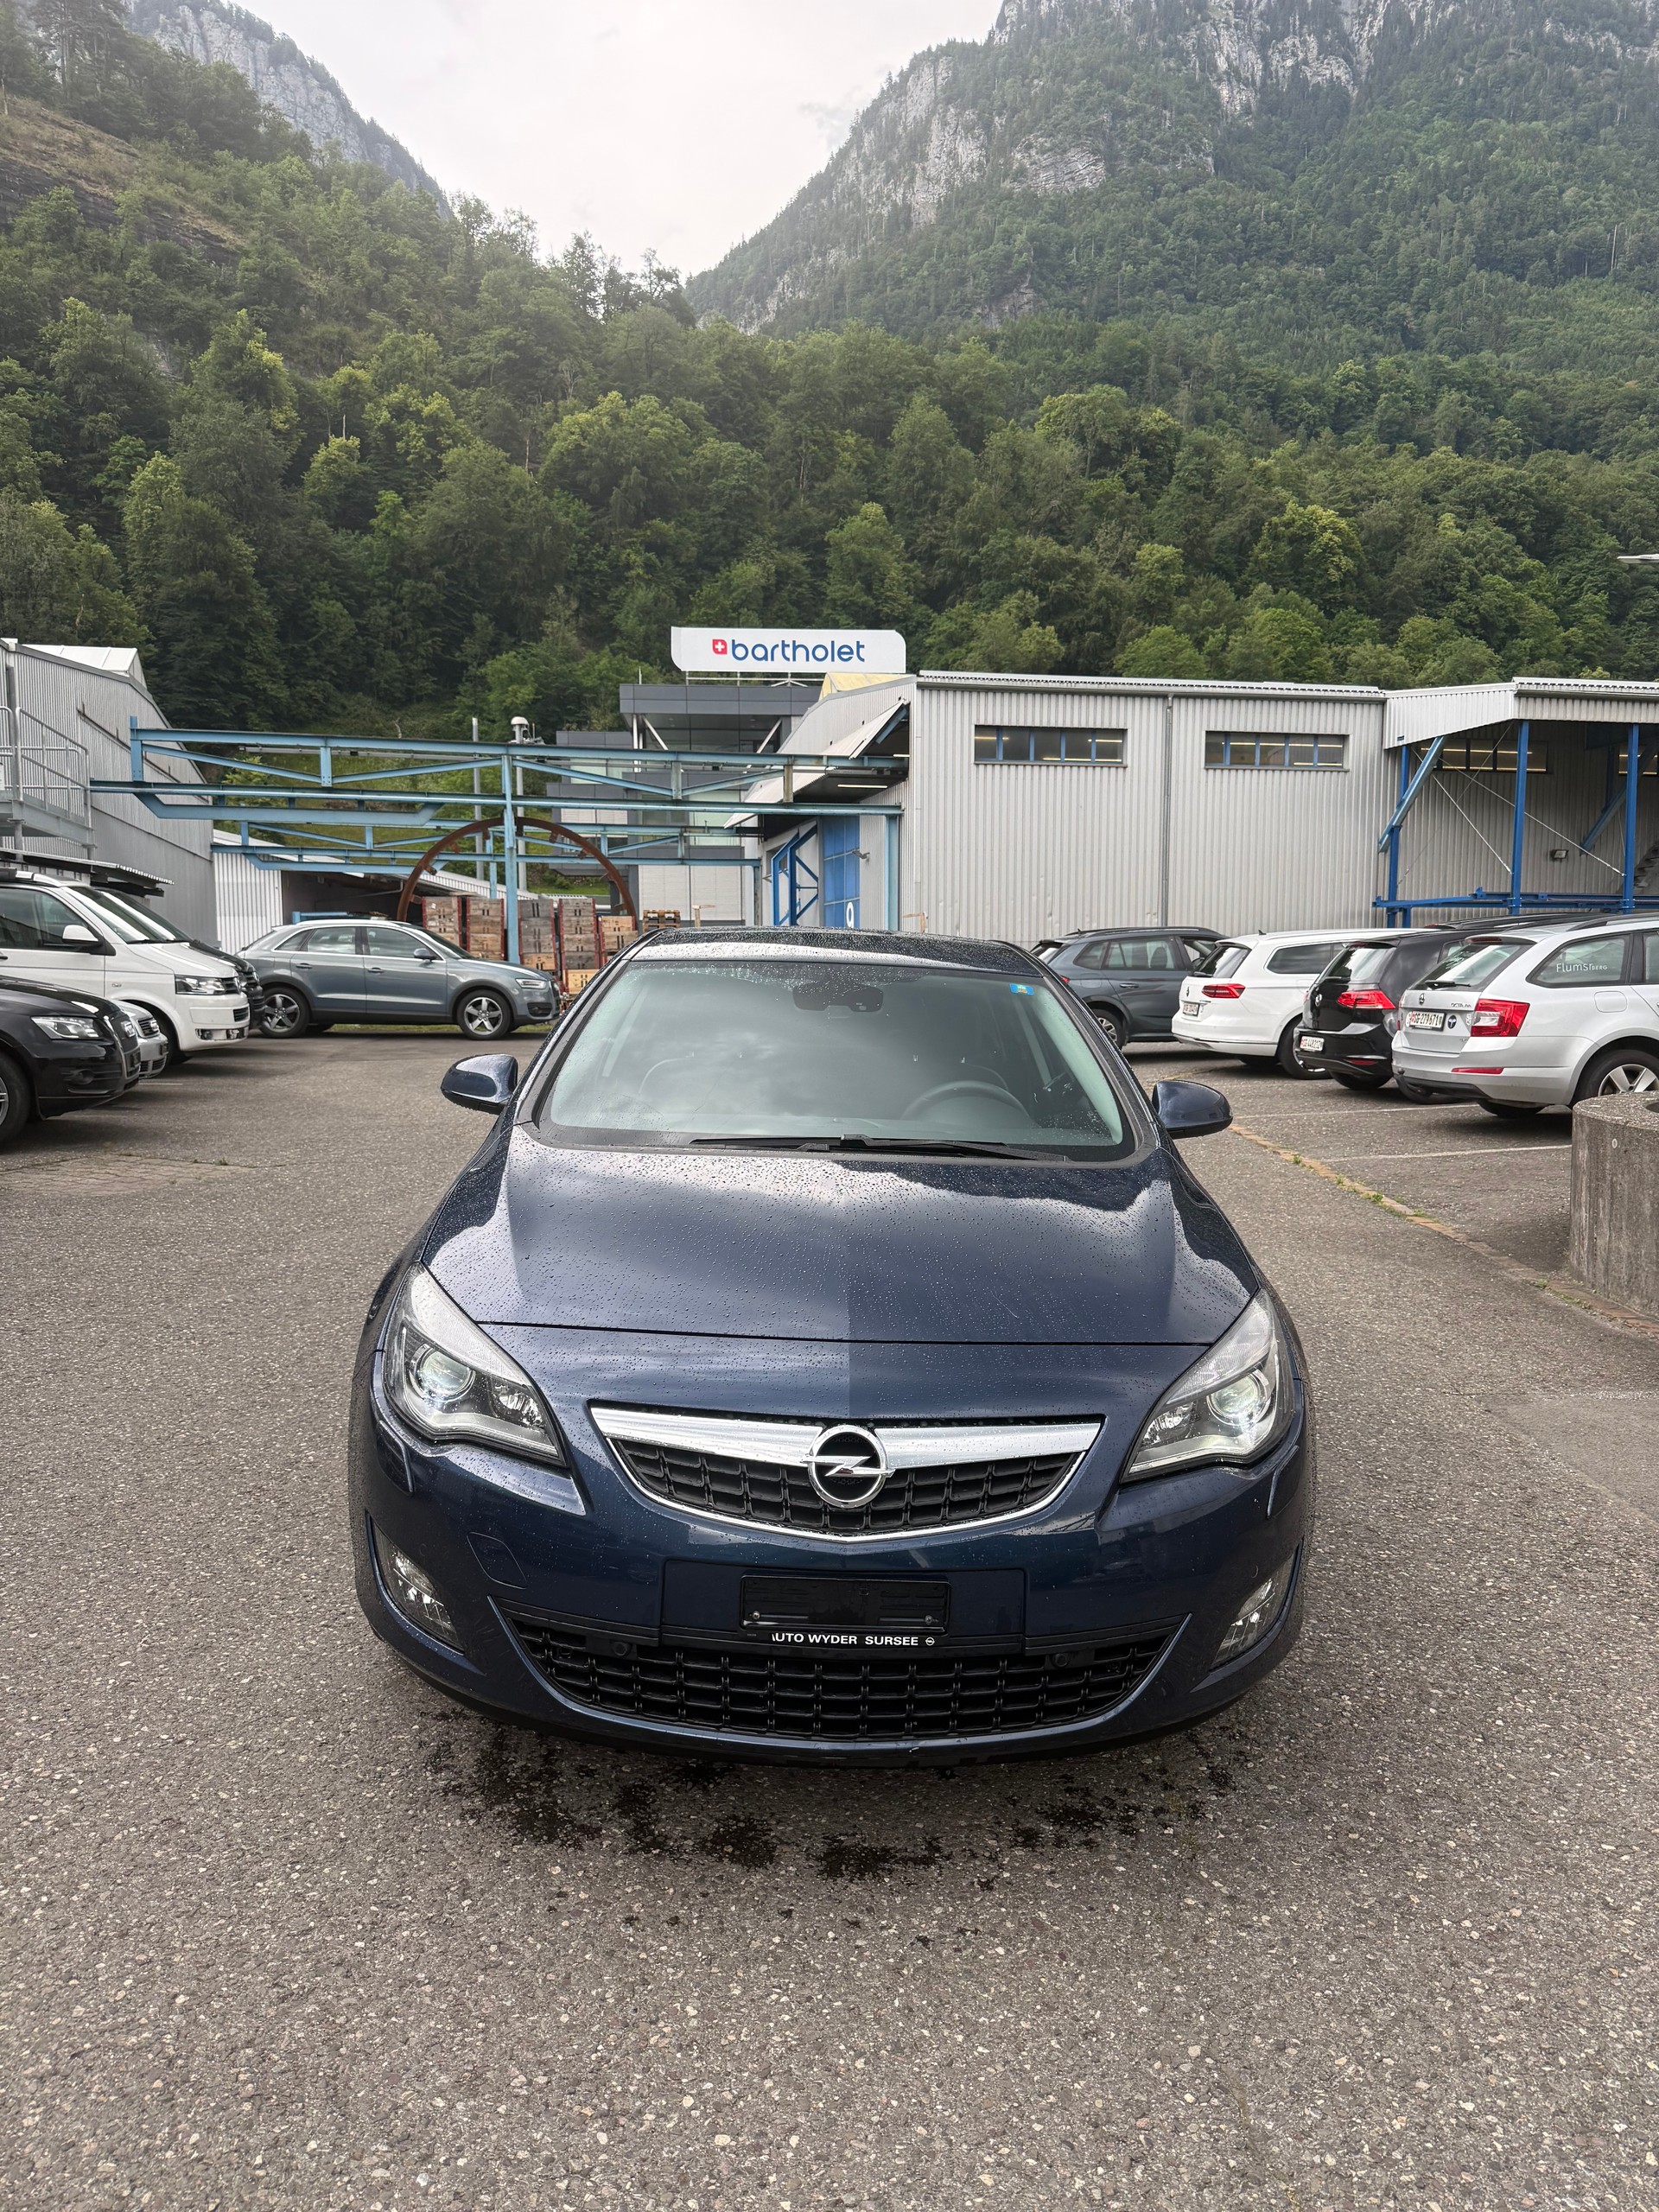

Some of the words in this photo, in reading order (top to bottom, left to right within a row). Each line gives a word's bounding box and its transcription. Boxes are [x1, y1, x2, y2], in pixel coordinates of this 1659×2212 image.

[731, 639, 865, 663] bartholet
[808, 1634, 858, 1645] WYDER
[864, 1636, 918, 1646] SURSEE
